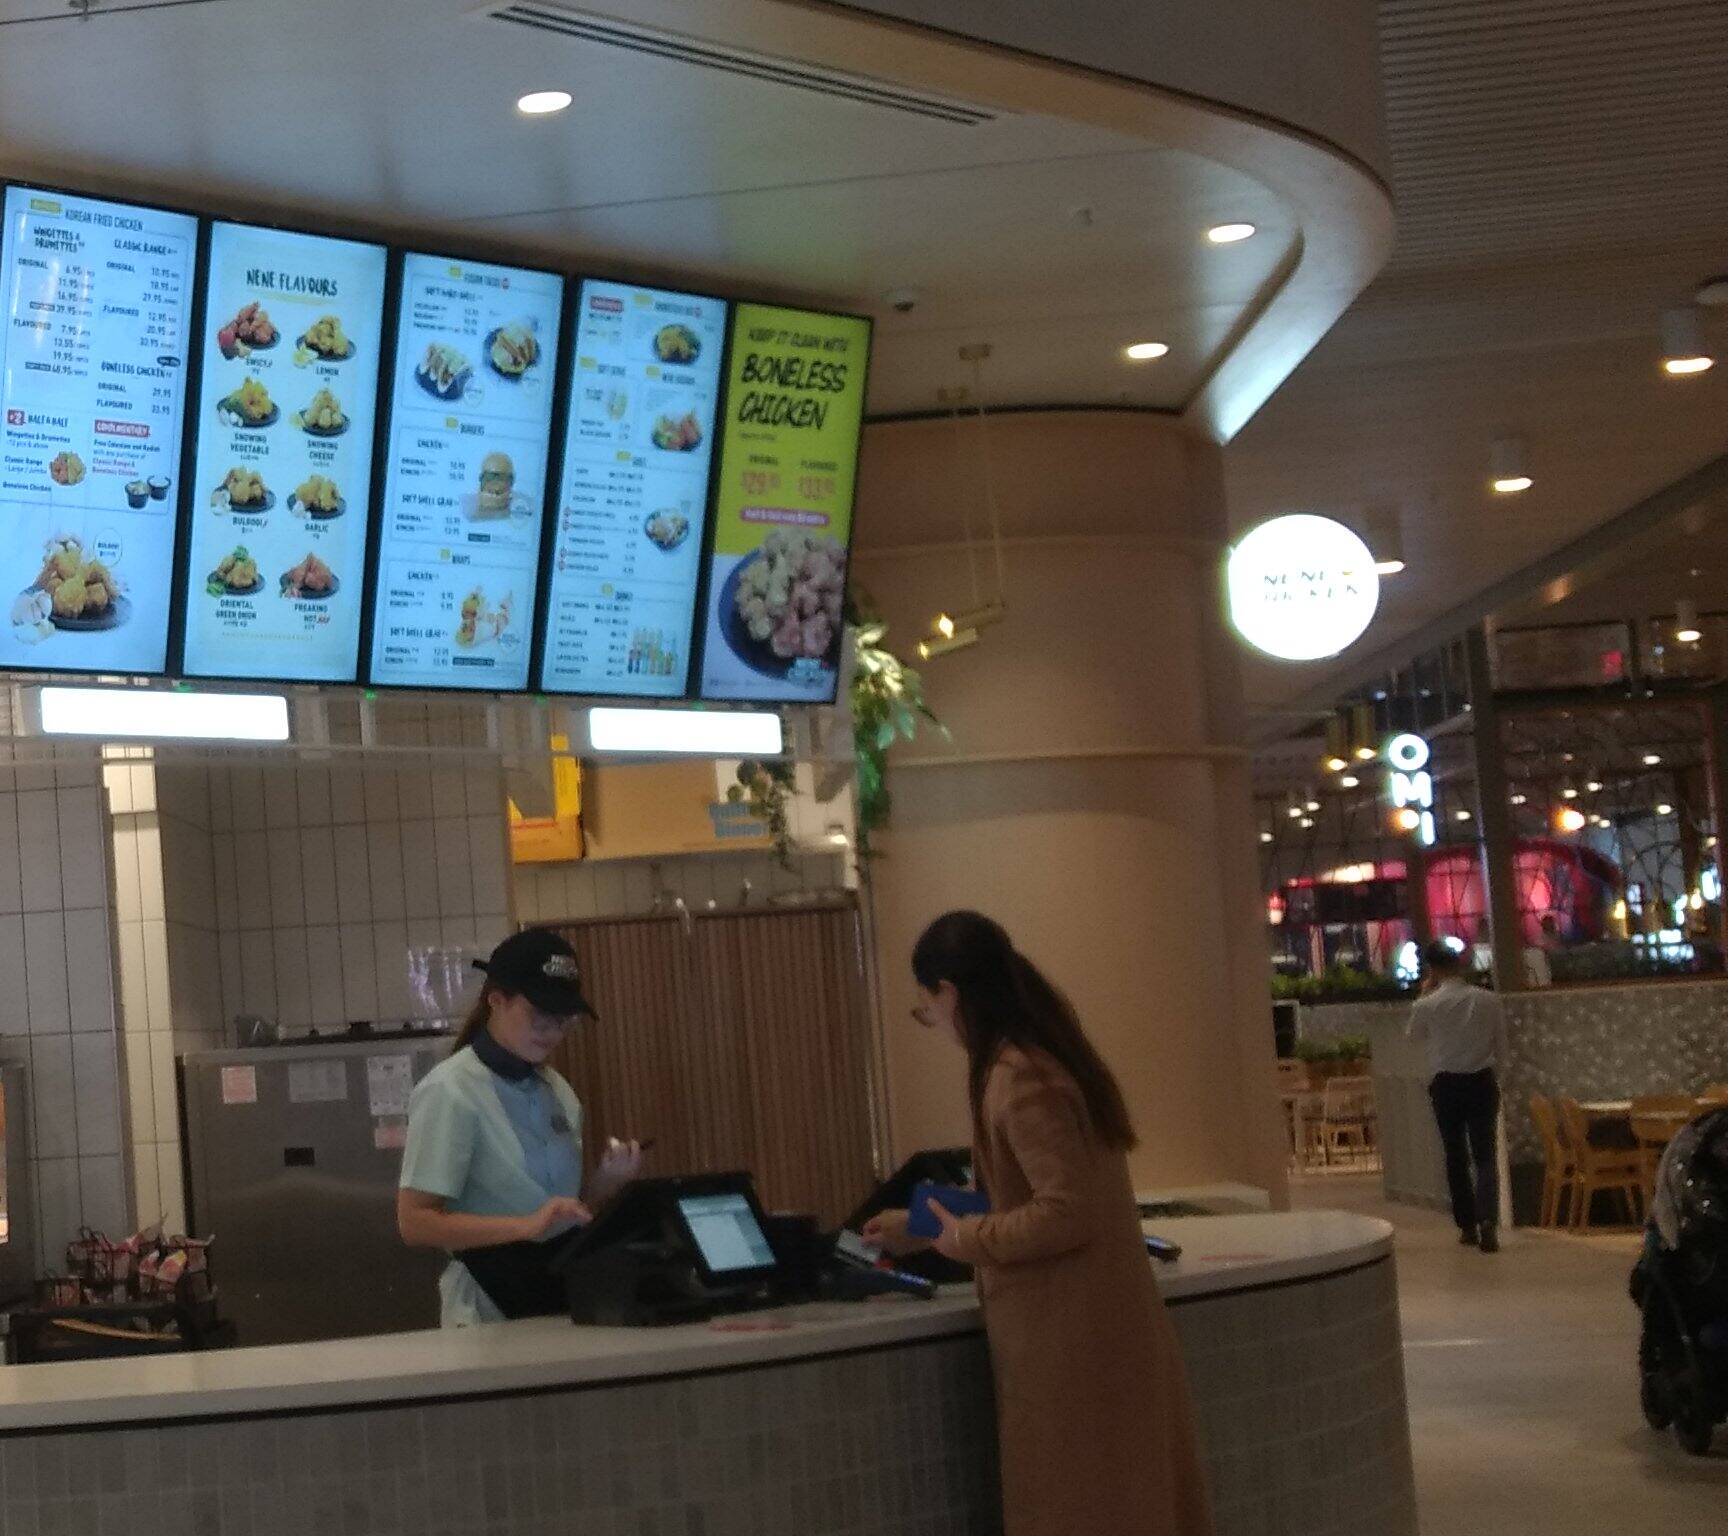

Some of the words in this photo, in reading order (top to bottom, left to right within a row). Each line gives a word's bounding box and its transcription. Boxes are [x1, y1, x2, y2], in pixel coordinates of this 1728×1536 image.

[246, 268, 275, 289] NENE
[279, 272, 338, 297] FLAVOURS
[316, 367, 339, 377] LEMON
[741, 352, 848, 393] BONELESS
[738, 390, 828, 430] CHICKEN
[234, 432, 267, 444] SNOWING
[230, 442, 270, 456] VEGETABLE
[307, 439, 338, 451] SNOWING
[309, 449, 335, 461] CHEESE
[305, 523, 329, 534] GARLIC
[220, 598, 254, 610] ORIENTAL
